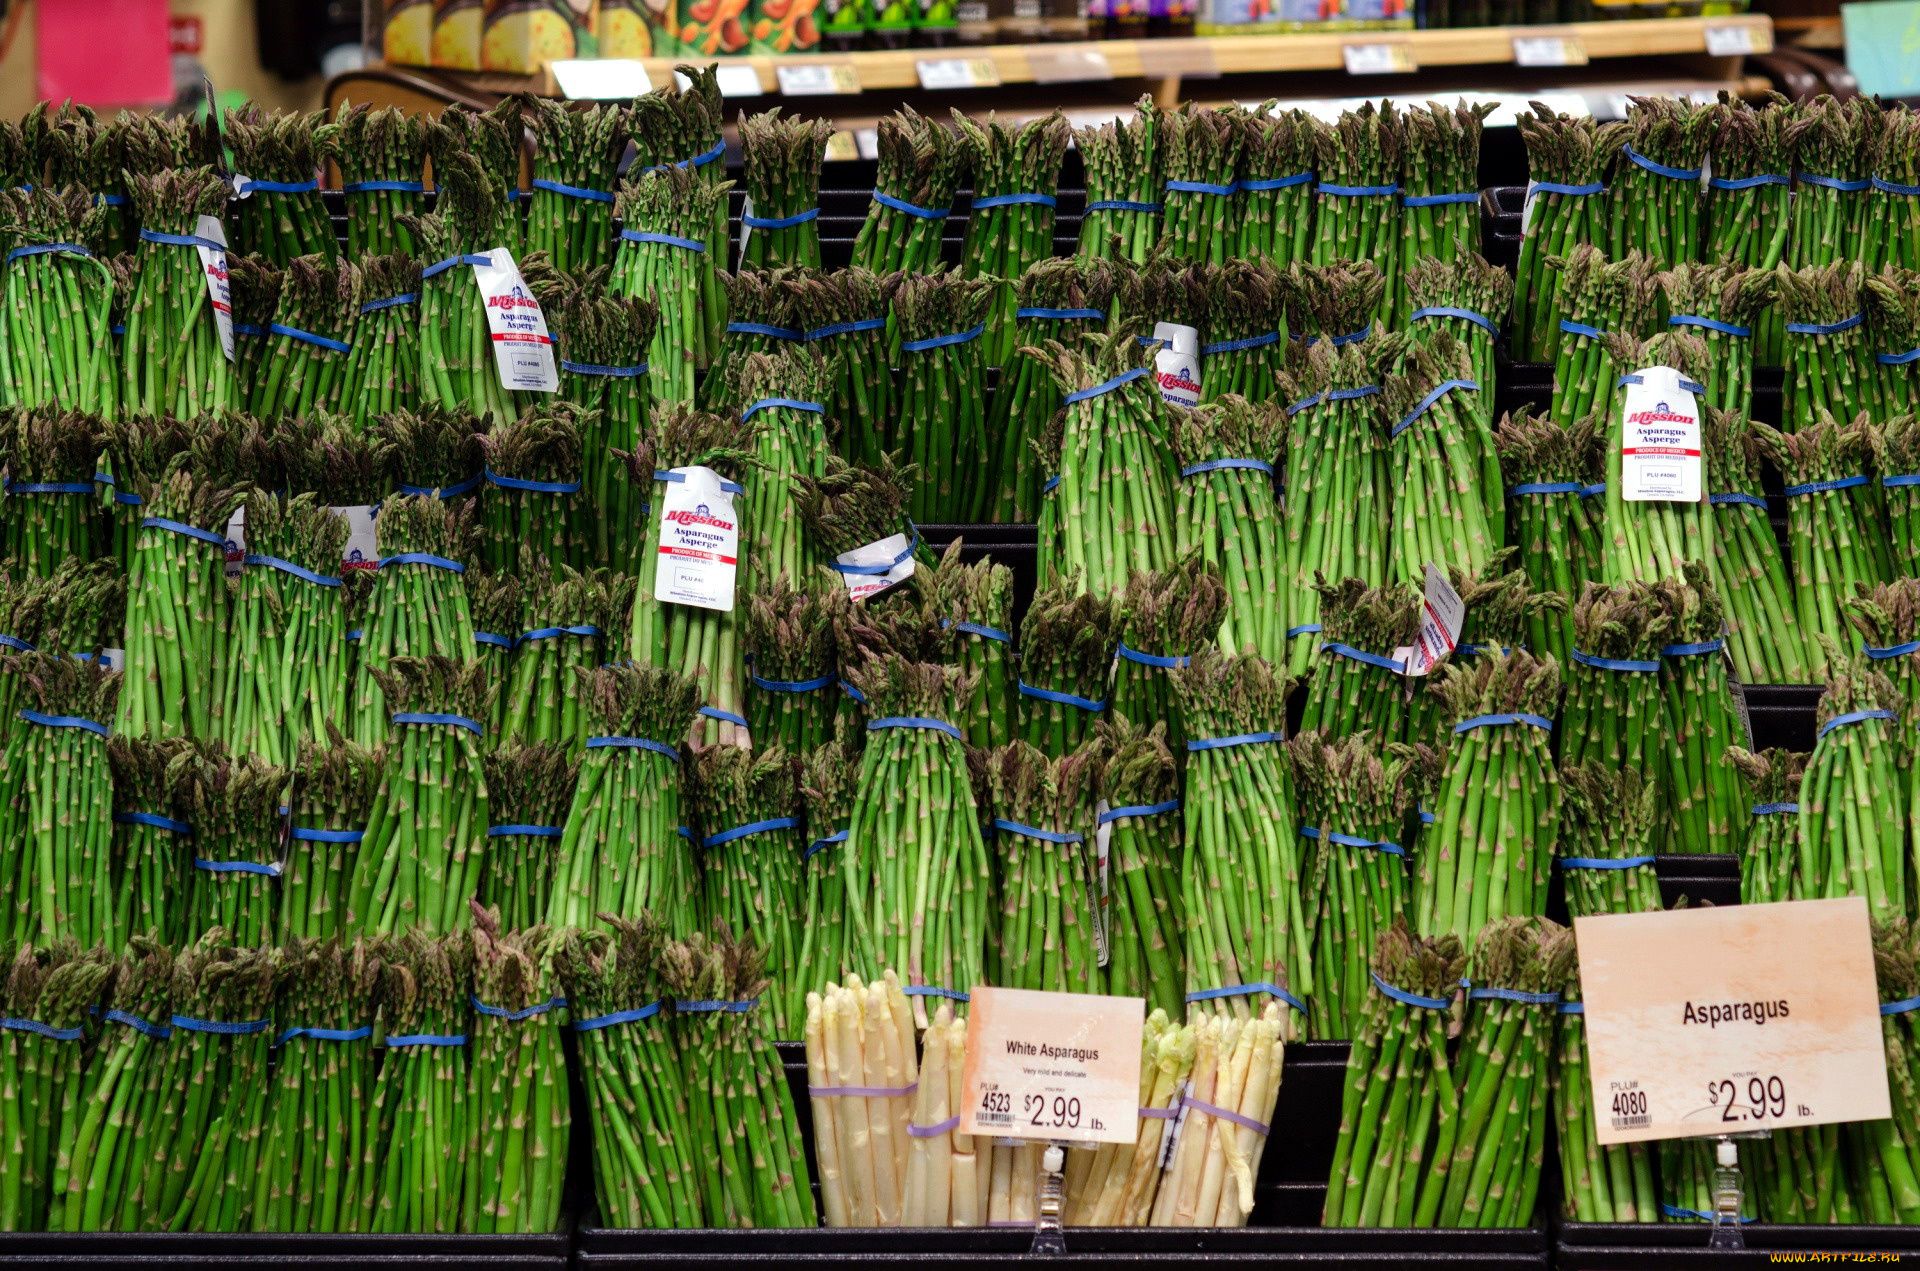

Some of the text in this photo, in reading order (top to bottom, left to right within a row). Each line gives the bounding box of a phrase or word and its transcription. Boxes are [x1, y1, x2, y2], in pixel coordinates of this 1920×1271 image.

[488, 295, 538, 310] Mission
[501, 312, 538, 323] Asparagus
[507, 321, 536, 331] Asperge
[1627, 411, 1695, 425] Mission
[1637, 428, 1686, 436] Asparagus
[1642, 436, 1681, 444] Asperge
[665, 510, 733, 531] Mission
[674, 527, 724, 541] Asparagus
[679, 537, 718, 549] Asperge
[1683, 999, 1790, 1028] Asparagus
[1006, 1040, 1099, 1062] White Asparagus
[1023, 1067, 1087, 1078] Very mild and delicate
[980, 1082, 999, 1091] PLU#
[1611, 1080, 1638, 1091] PLU#
[982, 1092, 1011, 1112] 4523
[1612, 1091, 1647, 1116] 4080
[1709, 1076, 1814, 1122] $2.99 lb.
[1024, 1094, 1107, 1131] $2.99 lb.
